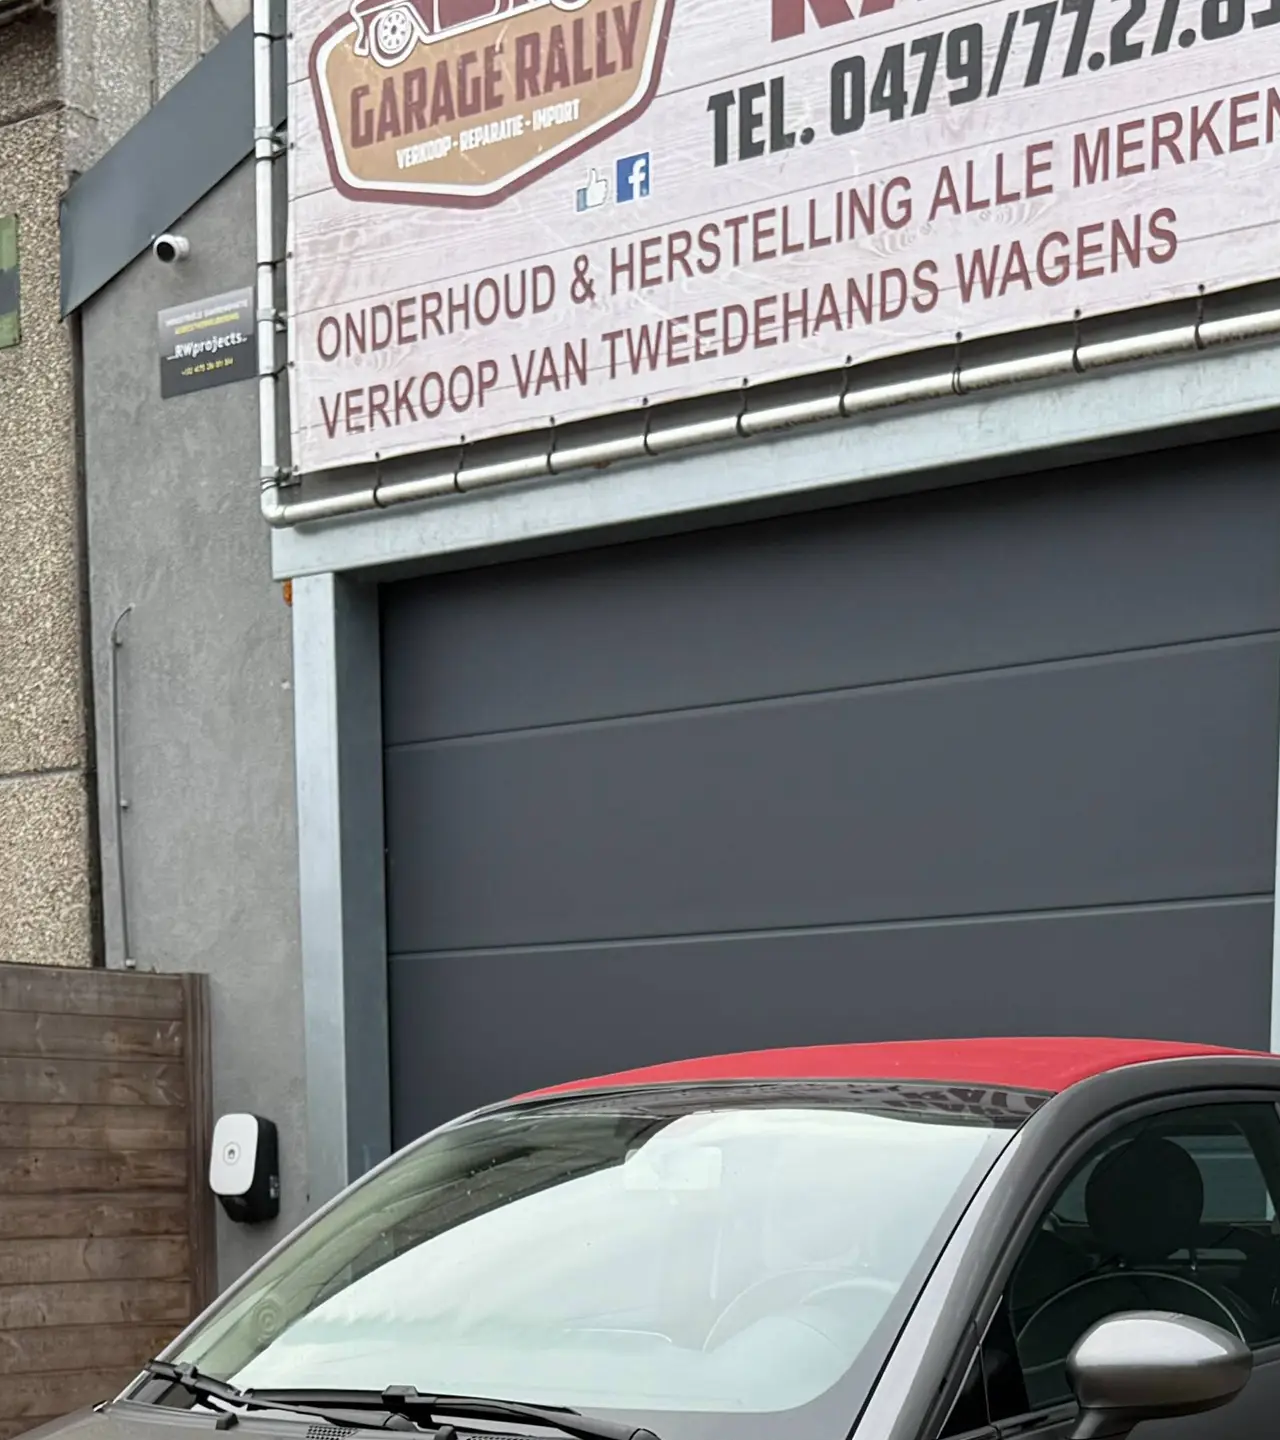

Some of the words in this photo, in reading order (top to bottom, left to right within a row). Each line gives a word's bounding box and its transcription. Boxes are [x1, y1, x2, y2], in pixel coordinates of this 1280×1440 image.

[350, 46, 505, 149] GARAGE
[515, 4, 641, 101] RALLY
[396, 136, 451, 169] VERKOOP
[459, 114, 524, 151] REPARATIE
[532, 98, 580, 131] IMPORT
[706, 75, 814, 168] TEL.
[317, 264, 555, 362] ONDERHOUD
[570, 254, 596, 301] &
[610, 176, 913, 295] HERSTELLING
[928, 141, 1053, 221] ALLE
[319, 359, 498, 439] VERKOOP
[512, 337, 587, 399] VAN
[601, 259, 939, 380] TWEEDEHANDS
[956, 207, 1178, 304] WAGENS
